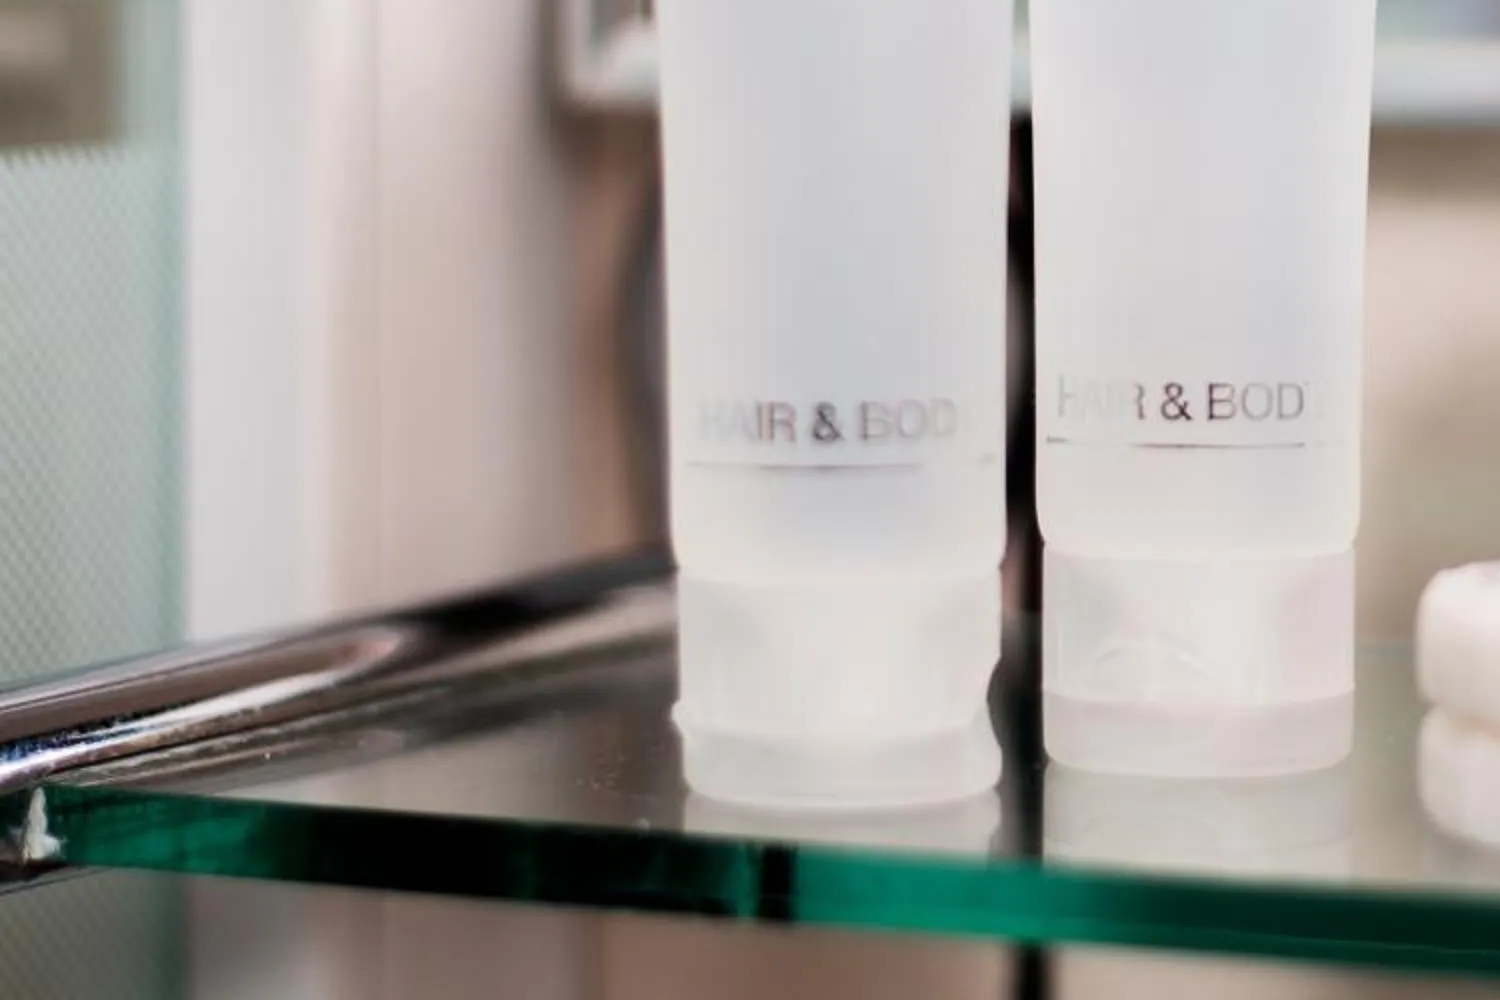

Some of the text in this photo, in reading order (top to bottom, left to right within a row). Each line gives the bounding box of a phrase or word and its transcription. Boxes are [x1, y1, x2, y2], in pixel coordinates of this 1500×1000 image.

[810, 400, 846, 445] &
[858, 397, 959, 443] BOD
[1159, 380, 1195, 422] &
[1206, 380, 1313, 422] BOD
